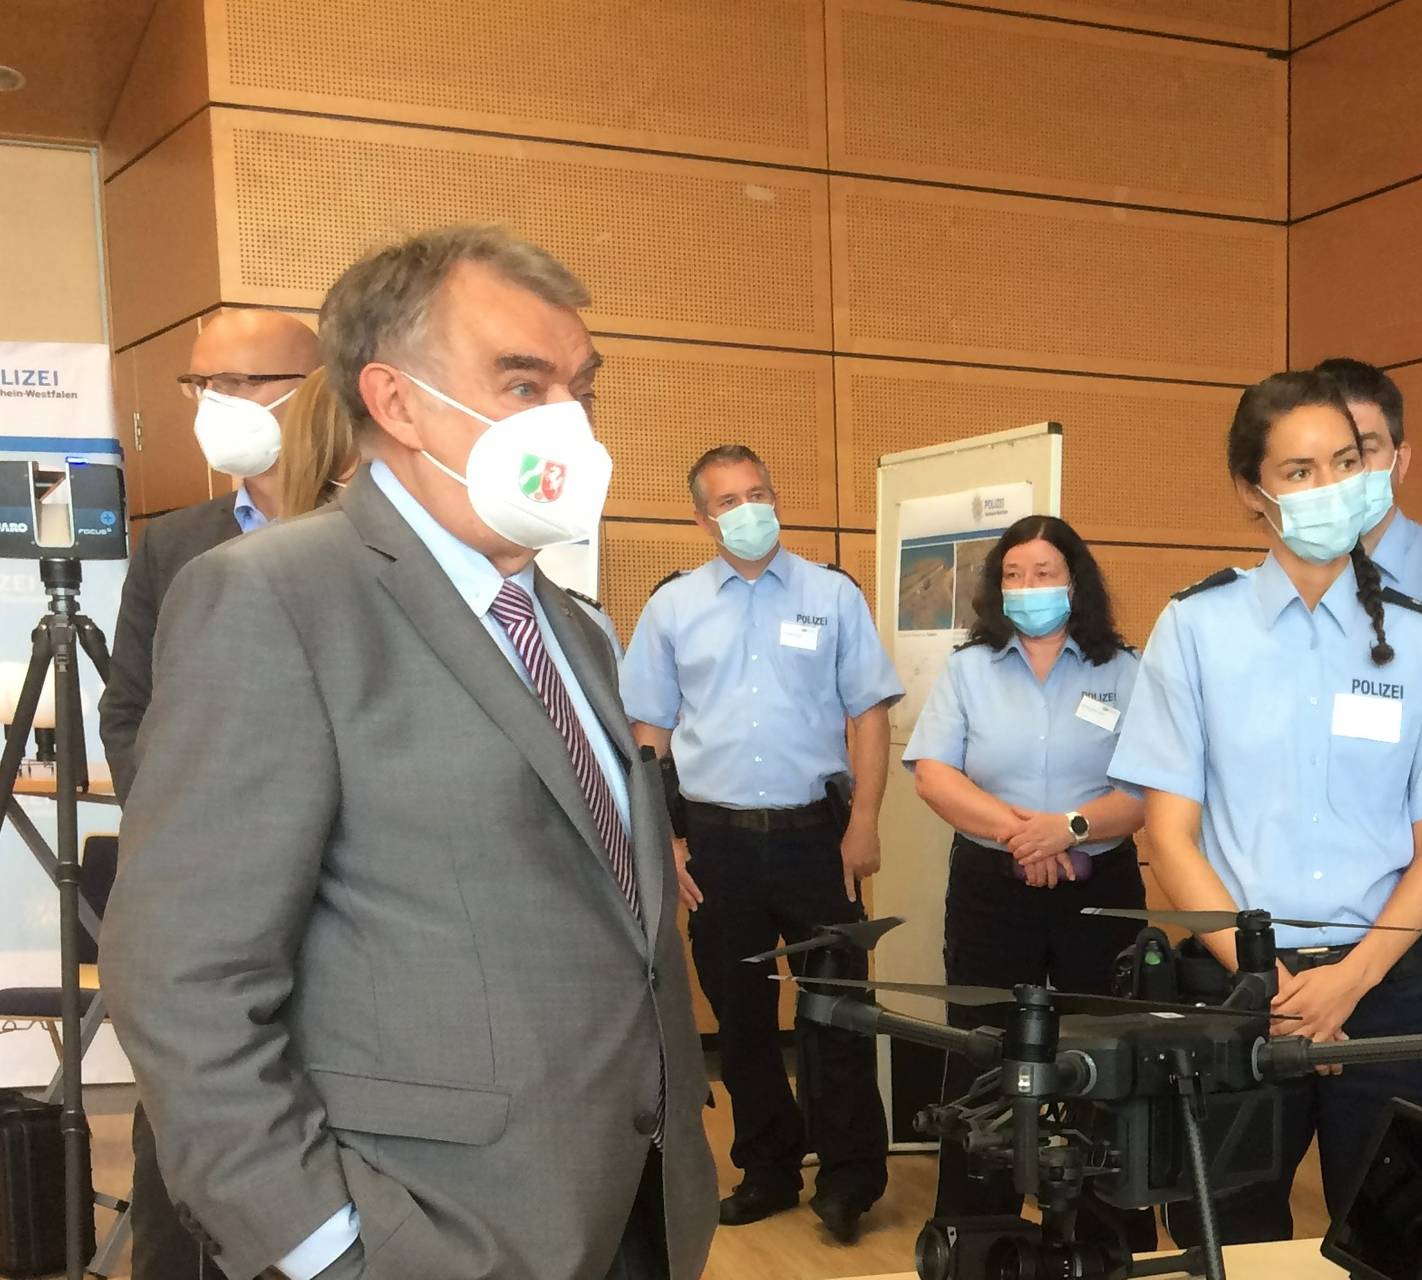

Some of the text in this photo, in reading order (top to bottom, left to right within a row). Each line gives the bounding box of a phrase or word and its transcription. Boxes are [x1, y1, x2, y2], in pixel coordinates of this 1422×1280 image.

[1, 369, 59, 386] LIZEI
[0, 523, 28, 533] ARO
[796, 614, 828, 626] POLIZEI
[1351, 679, 1404, 700] POLIZEI
